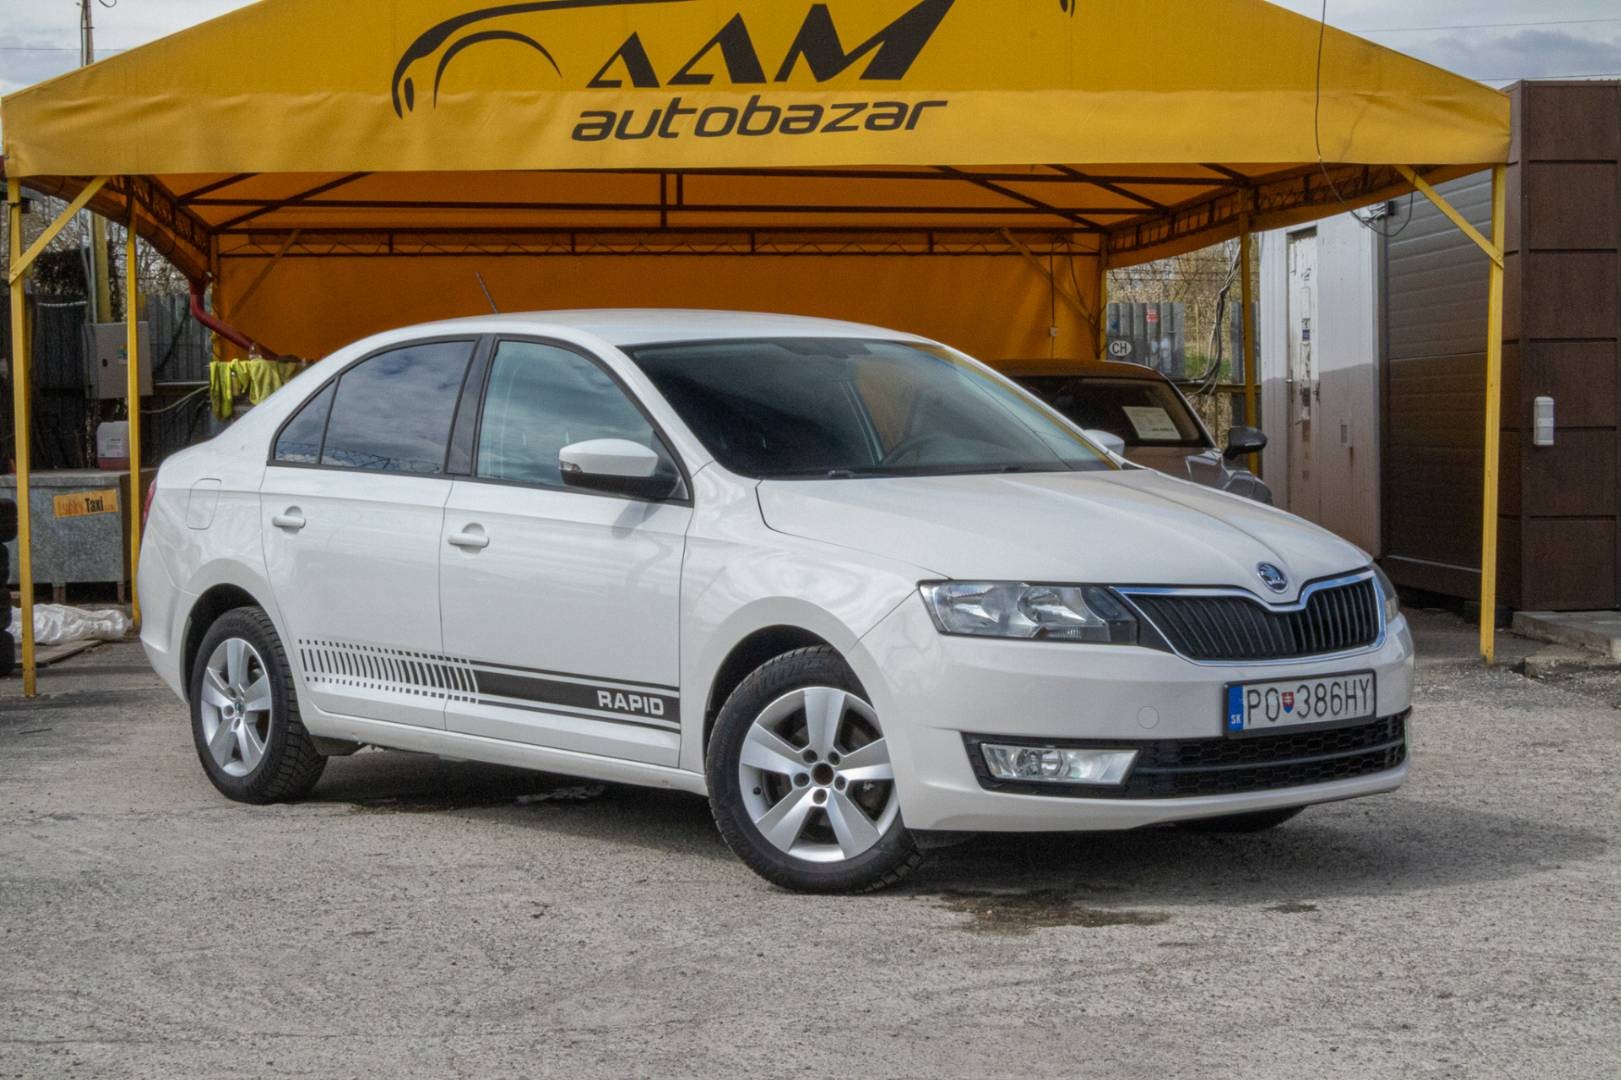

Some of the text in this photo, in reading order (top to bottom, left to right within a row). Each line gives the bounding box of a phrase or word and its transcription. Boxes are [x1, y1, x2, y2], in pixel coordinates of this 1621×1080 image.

[585, 0, 956, 89] AAM
[570, 95, 949, 142] autobazar
[1112, 342, 1128, 354] CH
[84, 495, 105, 514] Taxi
[596, 689, 665, 716] RAPID
[1230, 713, 1242, 725] SK
